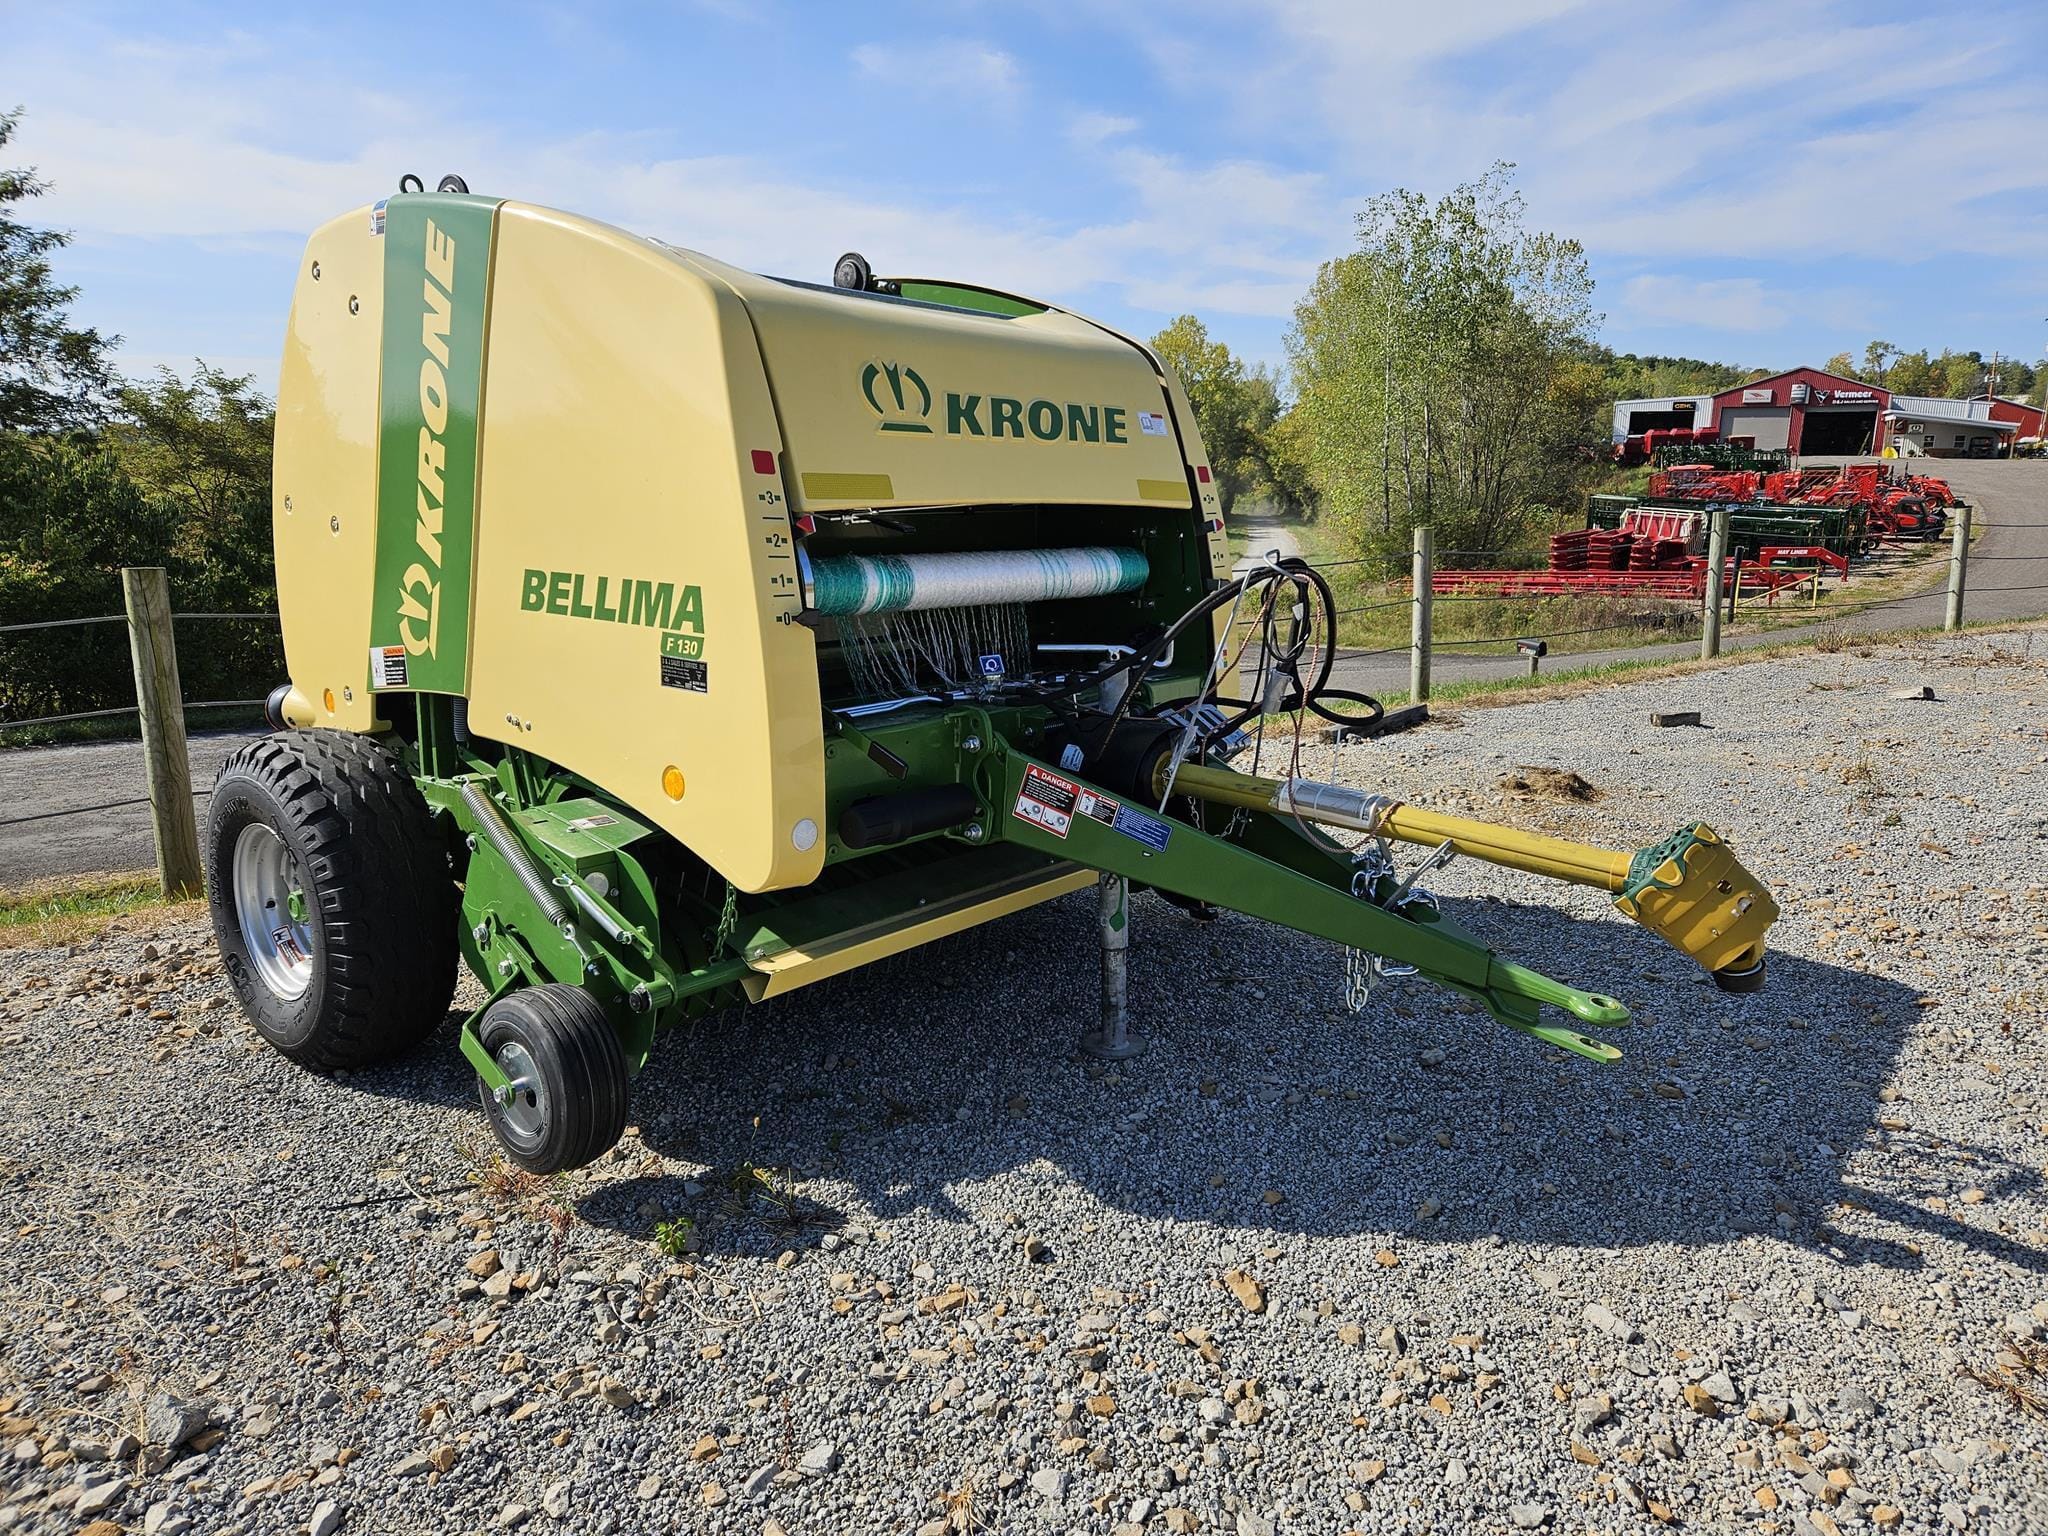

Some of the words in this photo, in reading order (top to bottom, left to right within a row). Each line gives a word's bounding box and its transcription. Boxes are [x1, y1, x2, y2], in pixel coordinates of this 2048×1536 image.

[416, 218, 456, 568] KRONE
[1834, 389, 1873, 398] Vermeer
[946, 393, 1128, 444] KRONE
[766, 490, 774, 505] 3
[773, 533, 781, 548] 2
[779, 574, 785, 588] 1
[521, 569, 705, 634] BELLIMA
[784, 611, 791, 626] 0
[667, 637, 674, 651] F
[677, 639, 698, 655] 130
[1040, 773, 1073, 792] DANGER
